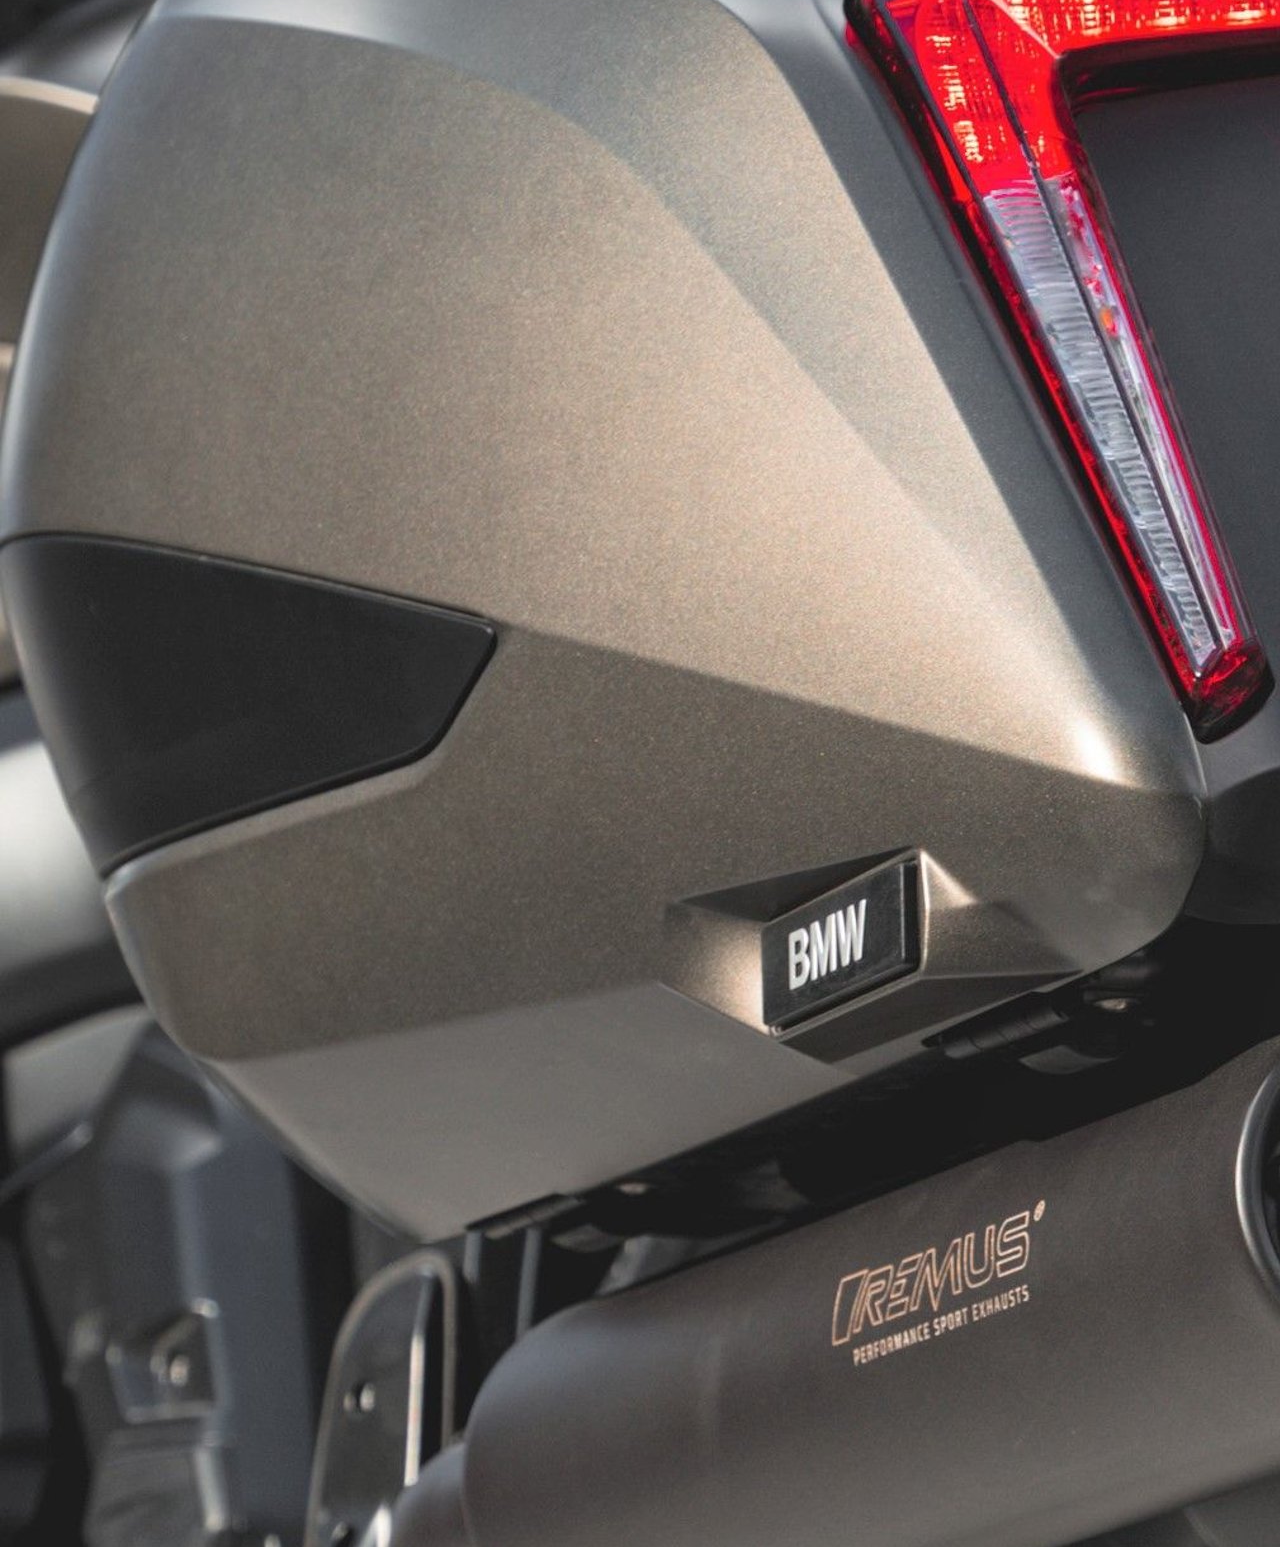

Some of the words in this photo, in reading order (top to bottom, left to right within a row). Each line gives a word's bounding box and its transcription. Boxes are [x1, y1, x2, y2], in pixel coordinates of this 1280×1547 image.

[788, 898, 867, 991] BMW
[832, 1209, 1031, 1347] REMUS
[853, 1321, 931, 1367] PERFORMANCE
[933, 1307, 969, 1337] SPORT
[971, 1283, 1030, 1322] EXHAUSTS
